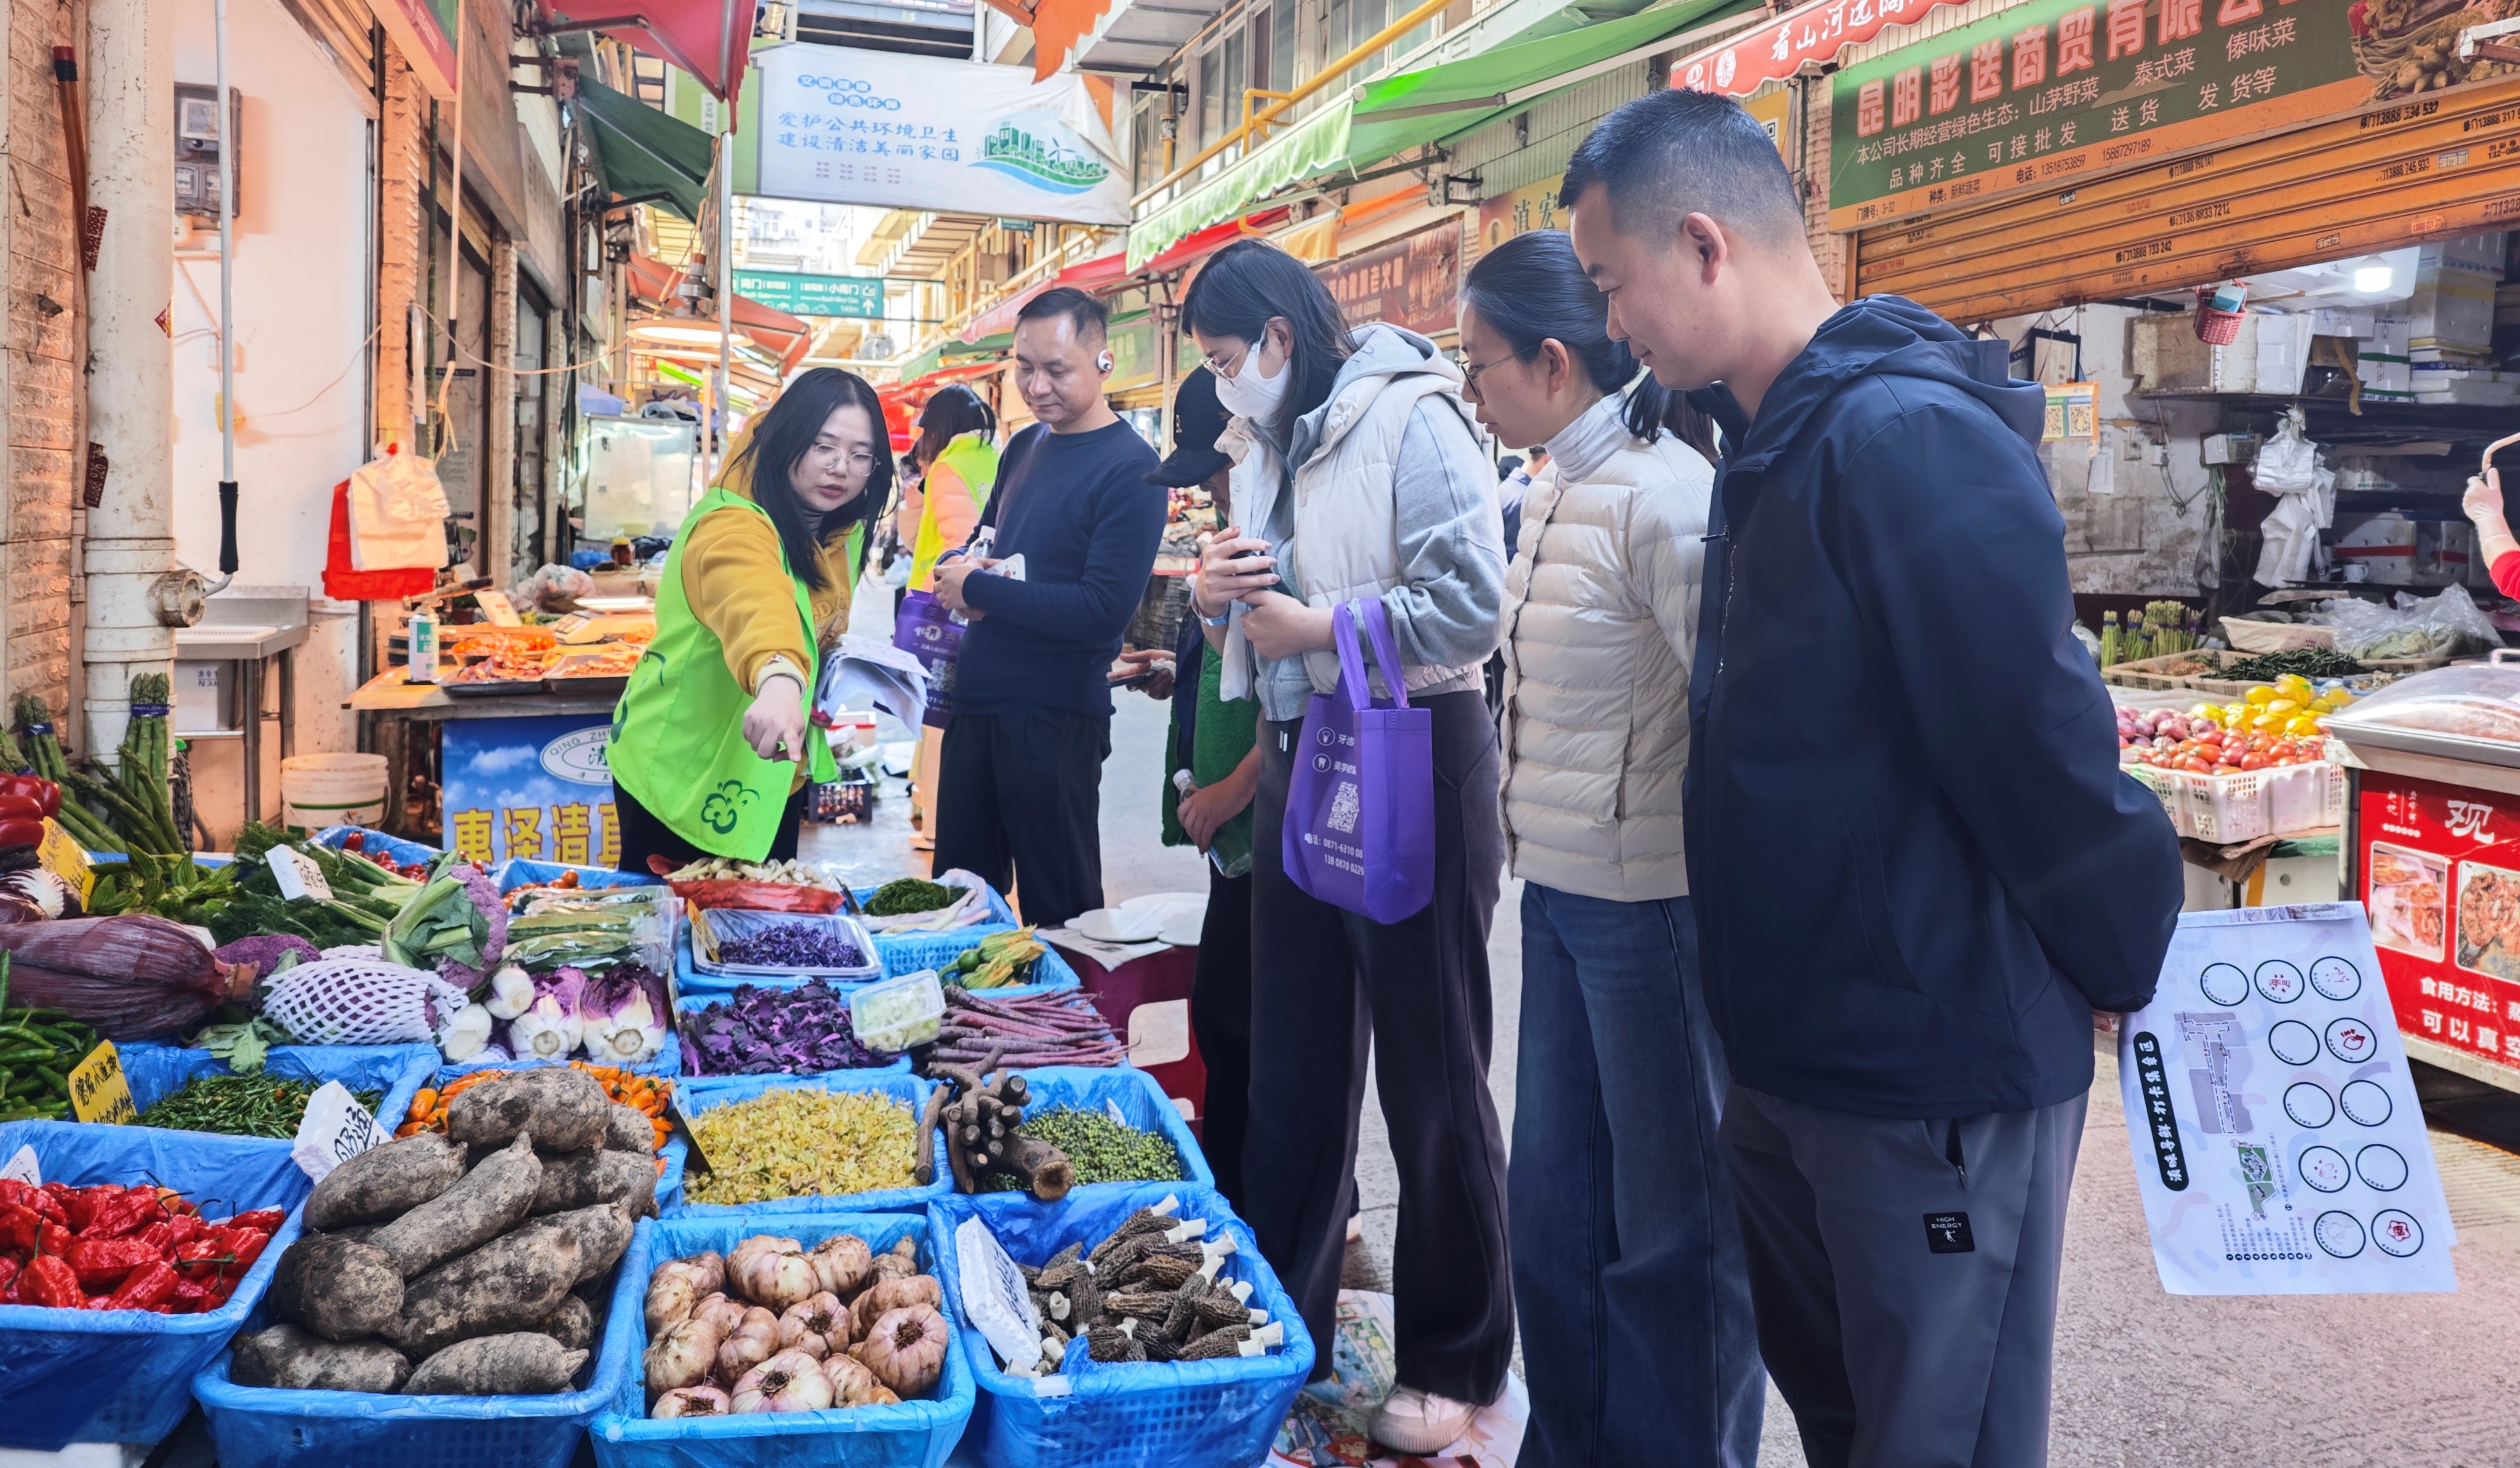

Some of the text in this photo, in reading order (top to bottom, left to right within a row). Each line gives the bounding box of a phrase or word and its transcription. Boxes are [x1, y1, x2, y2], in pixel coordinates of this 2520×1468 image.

[2134, 48, 2196, 86] 泰式菜
[2226, 17, 2297, 62] 傣味菜
[778, 111, 958, 143] 爱护公共环境卫生
[2502, 111, 2515, 123] 317
[778, 132, 959, 161] 建设清洁美丽家园
[1889, 151, 1966, 189] 品种齐全
[1988, 121, 2077, 162] 可接批发
[2111, 99, 2159, 132] 送货
[2102, 138, 2151, 161] 15887297189
[1513, 192, 1559, 236] 滇宏
[2161, 240, 2172, 252] 242
[2445, 800, 2494, 844] 观
[1324, 854, 1334, 866] 138
[1335, 858, 1350, 871] 0870
